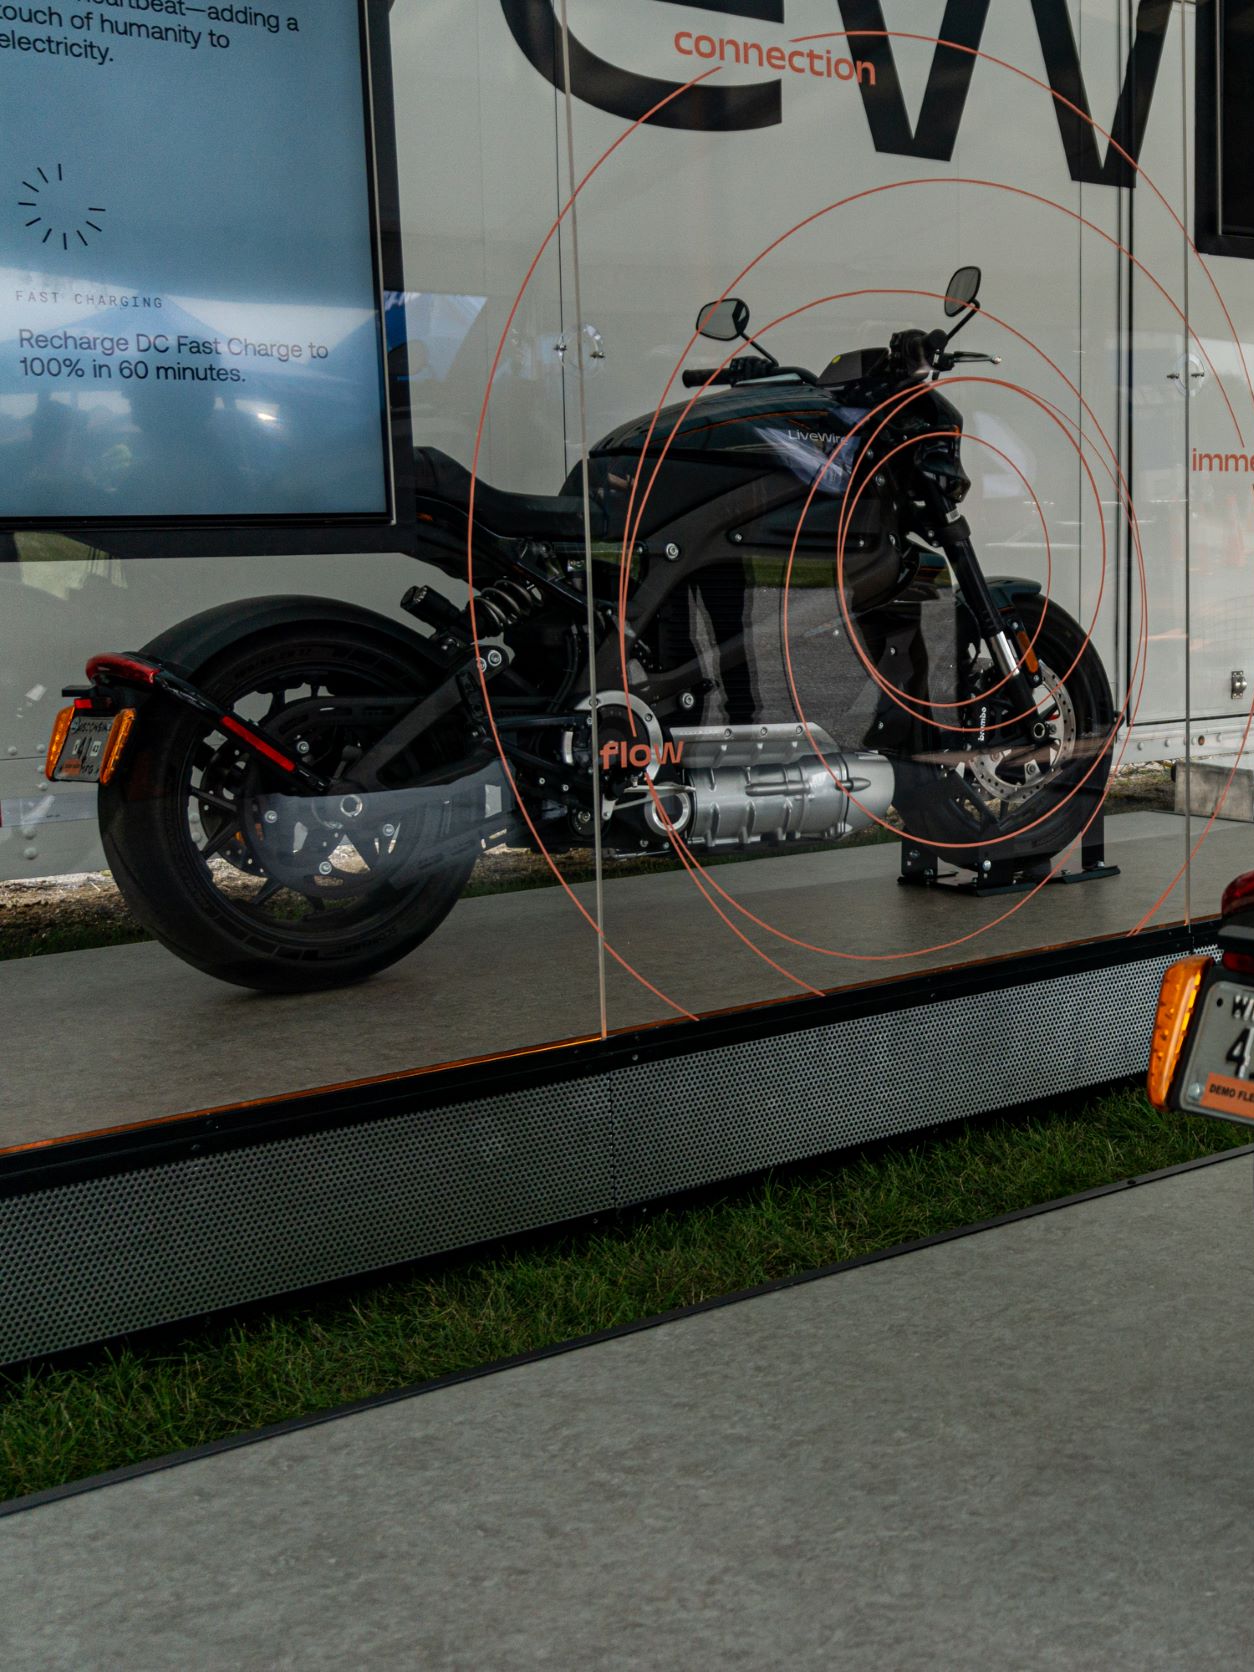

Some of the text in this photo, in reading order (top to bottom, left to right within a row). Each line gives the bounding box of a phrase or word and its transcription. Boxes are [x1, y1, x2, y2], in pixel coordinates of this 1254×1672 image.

[0, 5, 230, 49] ouch of humanity to
[287, 17, 299, 31] a
[0, 30, 114, 65] electricity.
[674, 31, 876, 86] connection
[16, 290, 163, 309] FAST CHARGING
[19, 328, 329, 362] Recharge DC Fast Charge to
[20, 357, 246, 383] 100% in 60 minutes.
[600, 741, 684, 770] flow
[1209, 1083, 1236, 1098] DEMO
